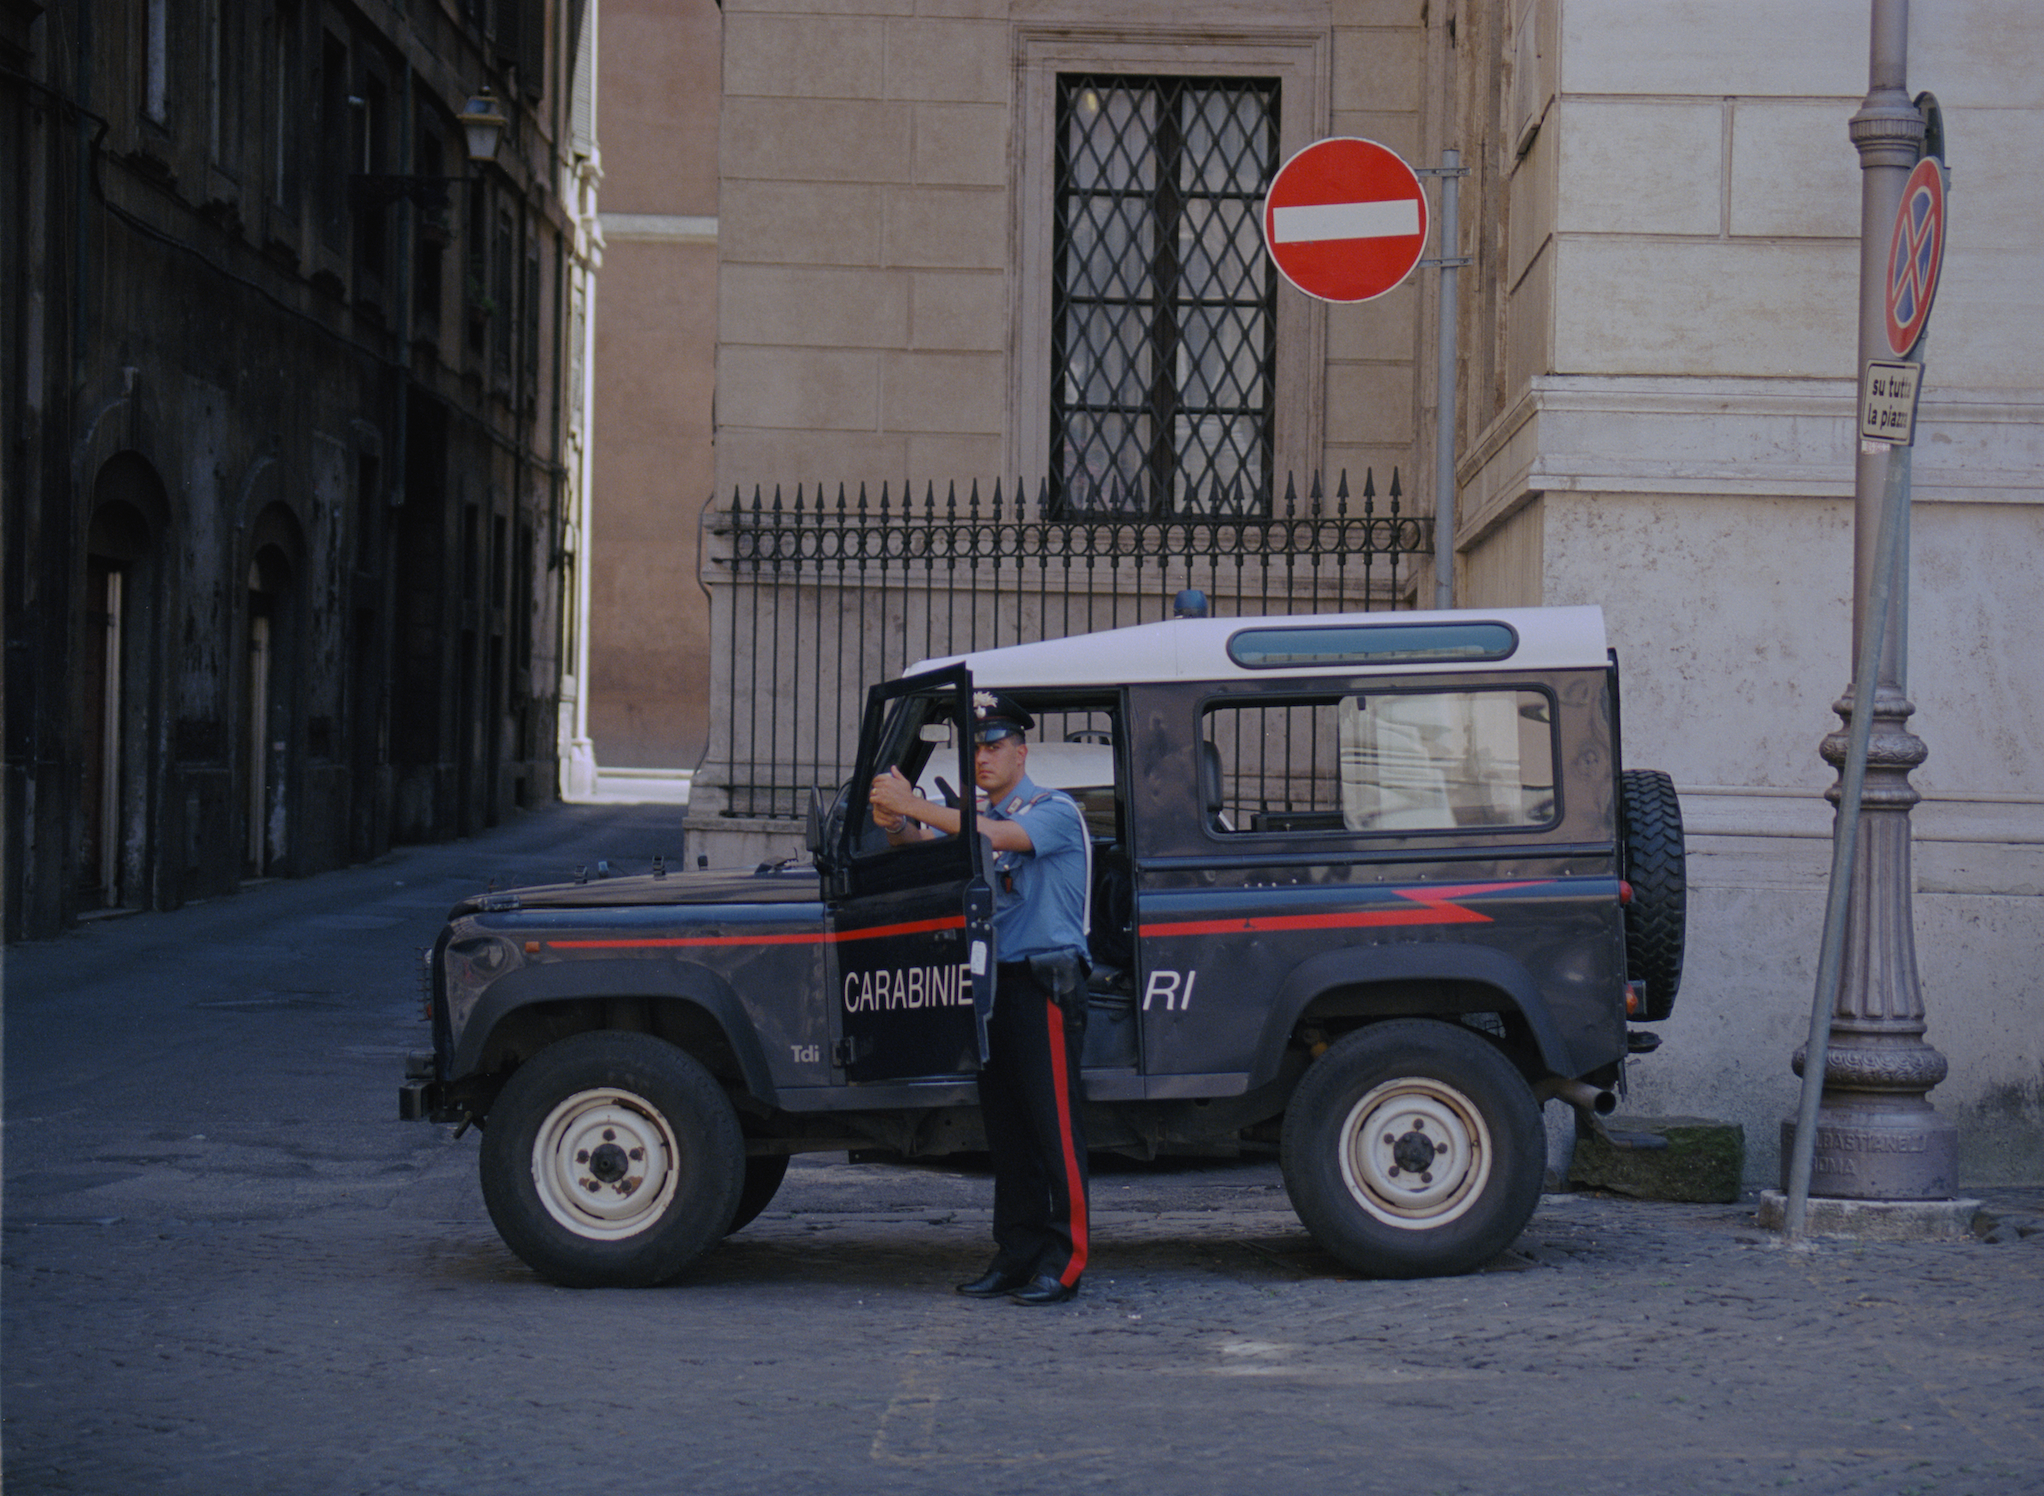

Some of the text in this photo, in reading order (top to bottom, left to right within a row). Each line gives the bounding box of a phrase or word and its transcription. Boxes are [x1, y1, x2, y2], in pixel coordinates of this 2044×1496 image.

[1872, 379, 1886, 397] su
[1868, 403, 1878, 425] la
[844, 963, 1197, 1013] CARABINIE RI
[791, 1044, 820, 1063] Tdi
